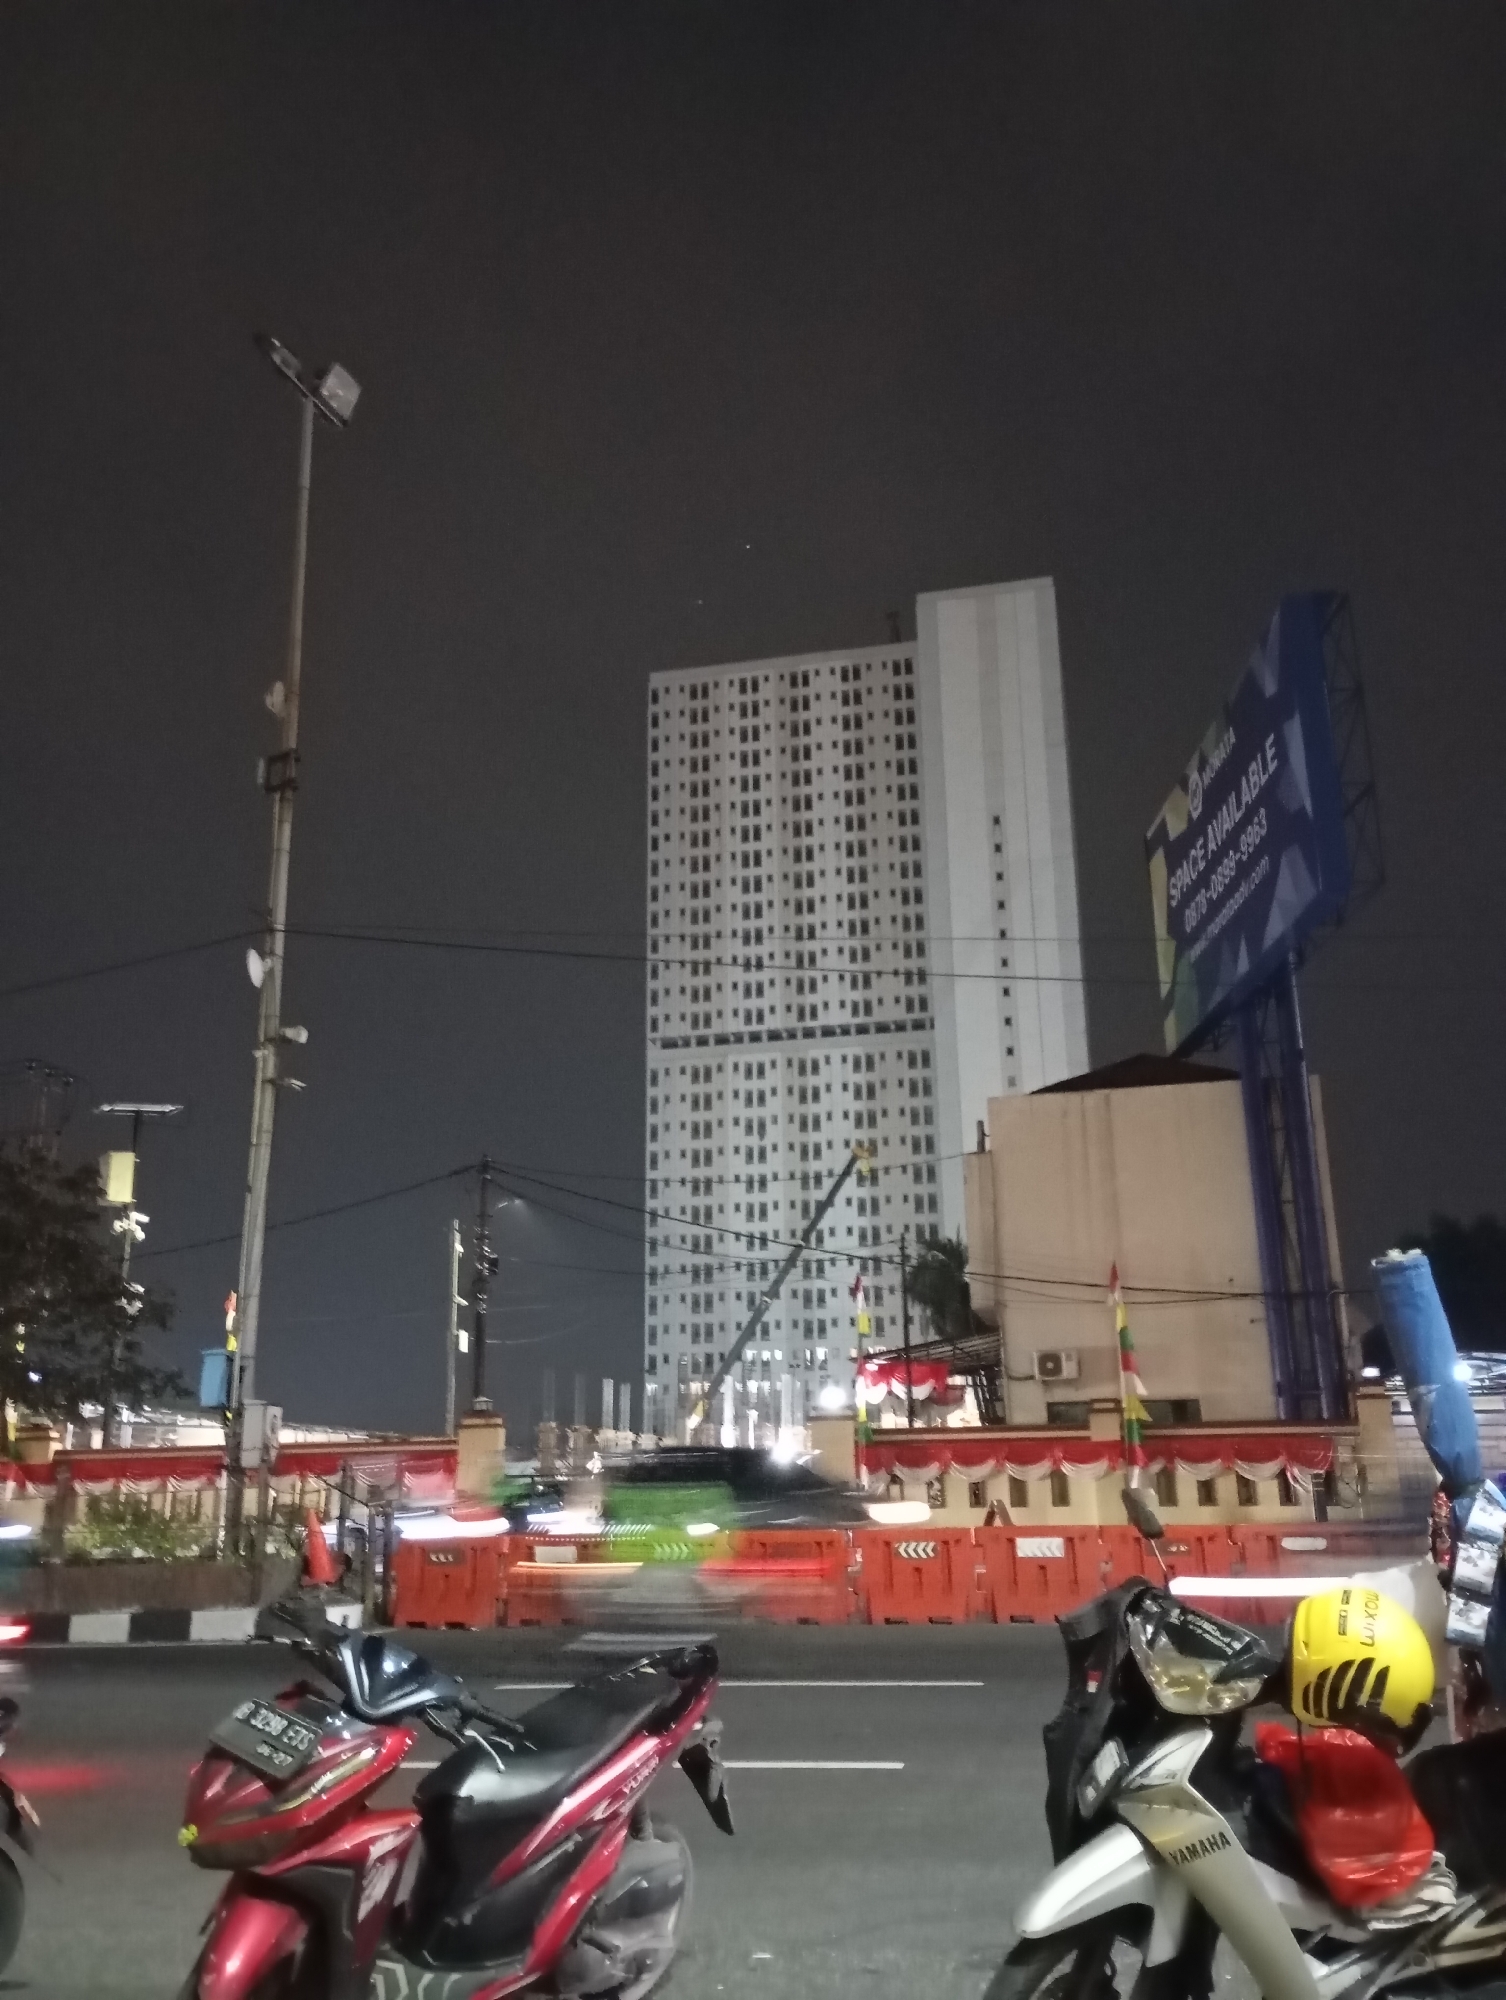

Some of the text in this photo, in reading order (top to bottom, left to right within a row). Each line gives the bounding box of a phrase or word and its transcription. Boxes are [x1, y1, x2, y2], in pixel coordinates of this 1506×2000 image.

[1169, 732, 1279, 908] SPACE AVAILABLE
[1168, 1831, 1232, 1865] YAMAHA
